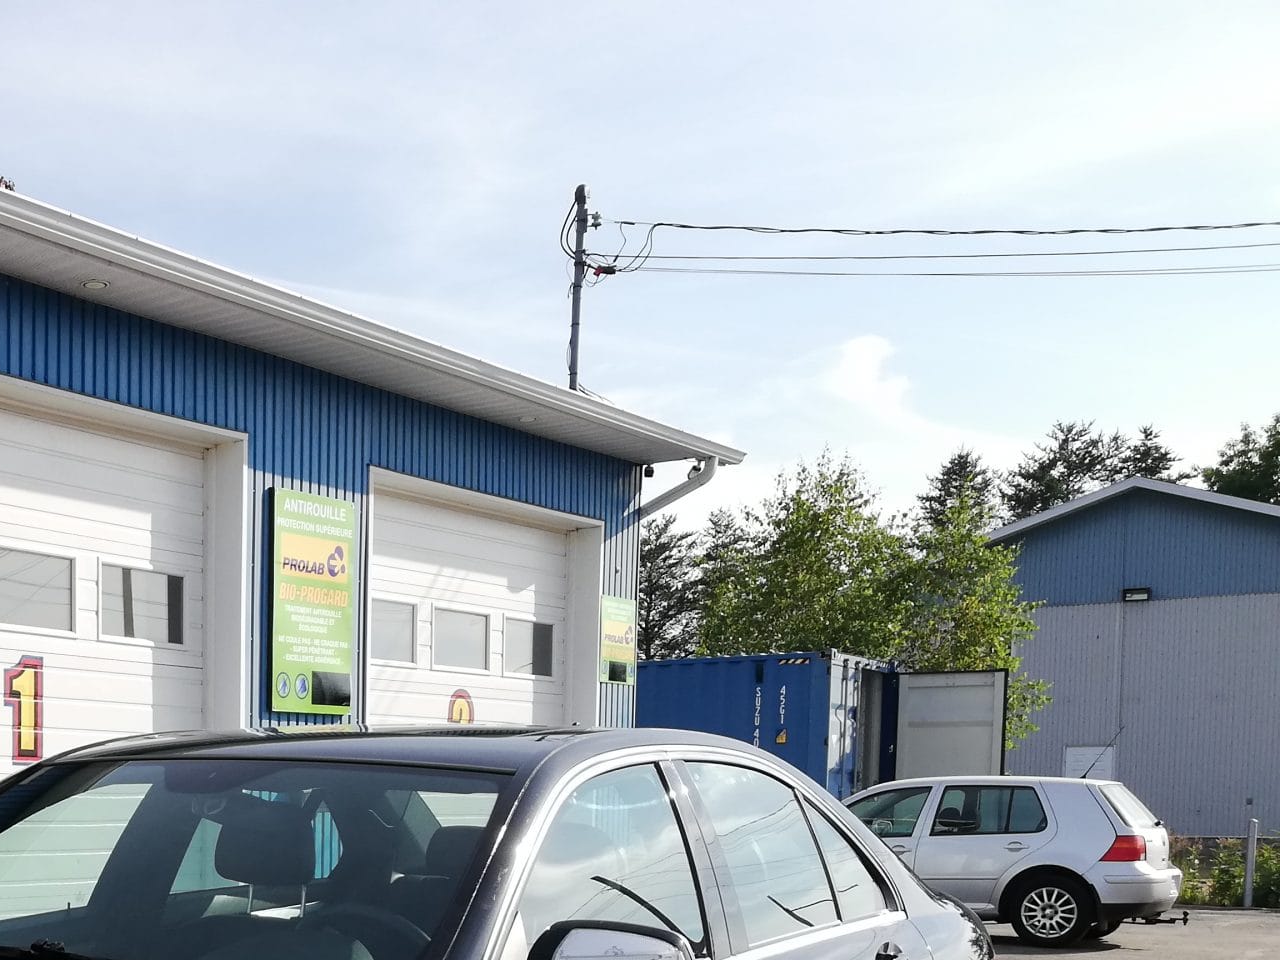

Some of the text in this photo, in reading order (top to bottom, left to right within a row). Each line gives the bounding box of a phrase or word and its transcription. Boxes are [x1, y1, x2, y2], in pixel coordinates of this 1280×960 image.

[283, 498, 347, 522] ANTIROUILLE
[277, 516, 316, 533] PROTECTION
[282, 556, 325, 576] PROLAB
[279, 582, 349, 608] BIO-PROGARD
[8, 659, 40, 760] 1
